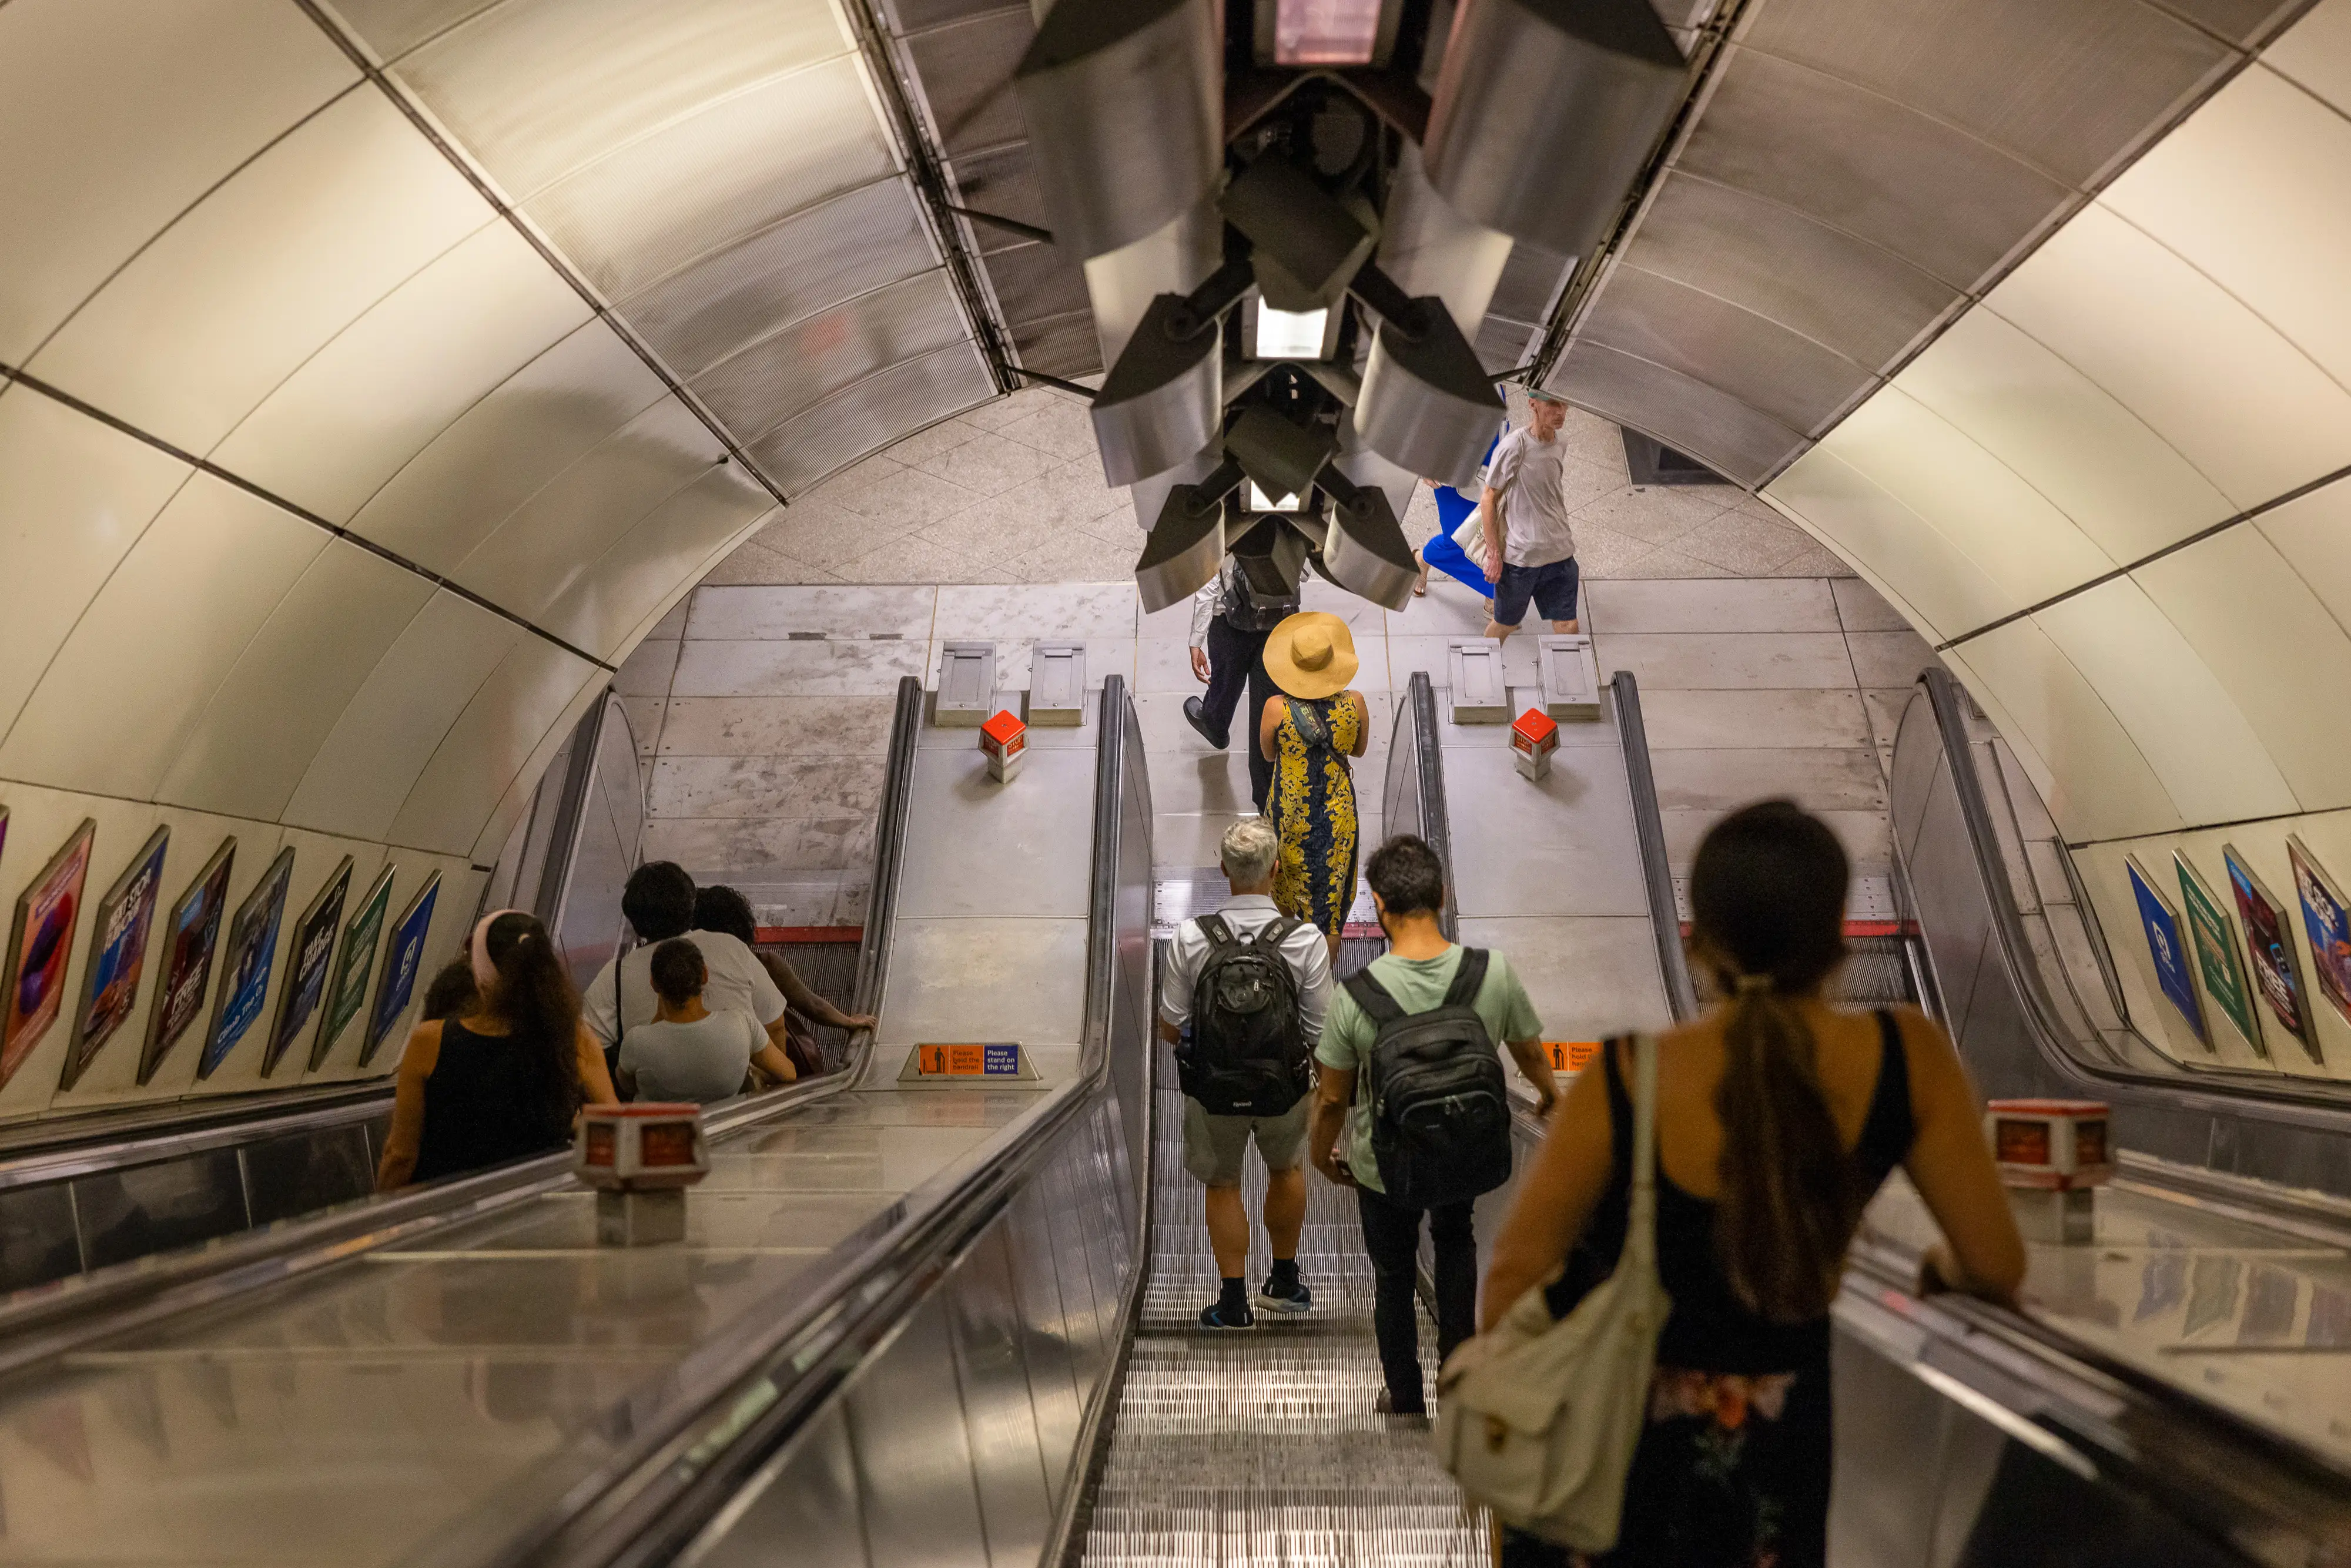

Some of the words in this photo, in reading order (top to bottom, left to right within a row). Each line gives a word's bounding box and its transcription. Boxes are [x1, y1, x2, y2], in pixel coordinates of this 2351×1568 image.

[1008, 736, 1023, 748] STOP
[172, 957, 205, 1015] FREE
[2255, 950, 2290, 1002] FREE
